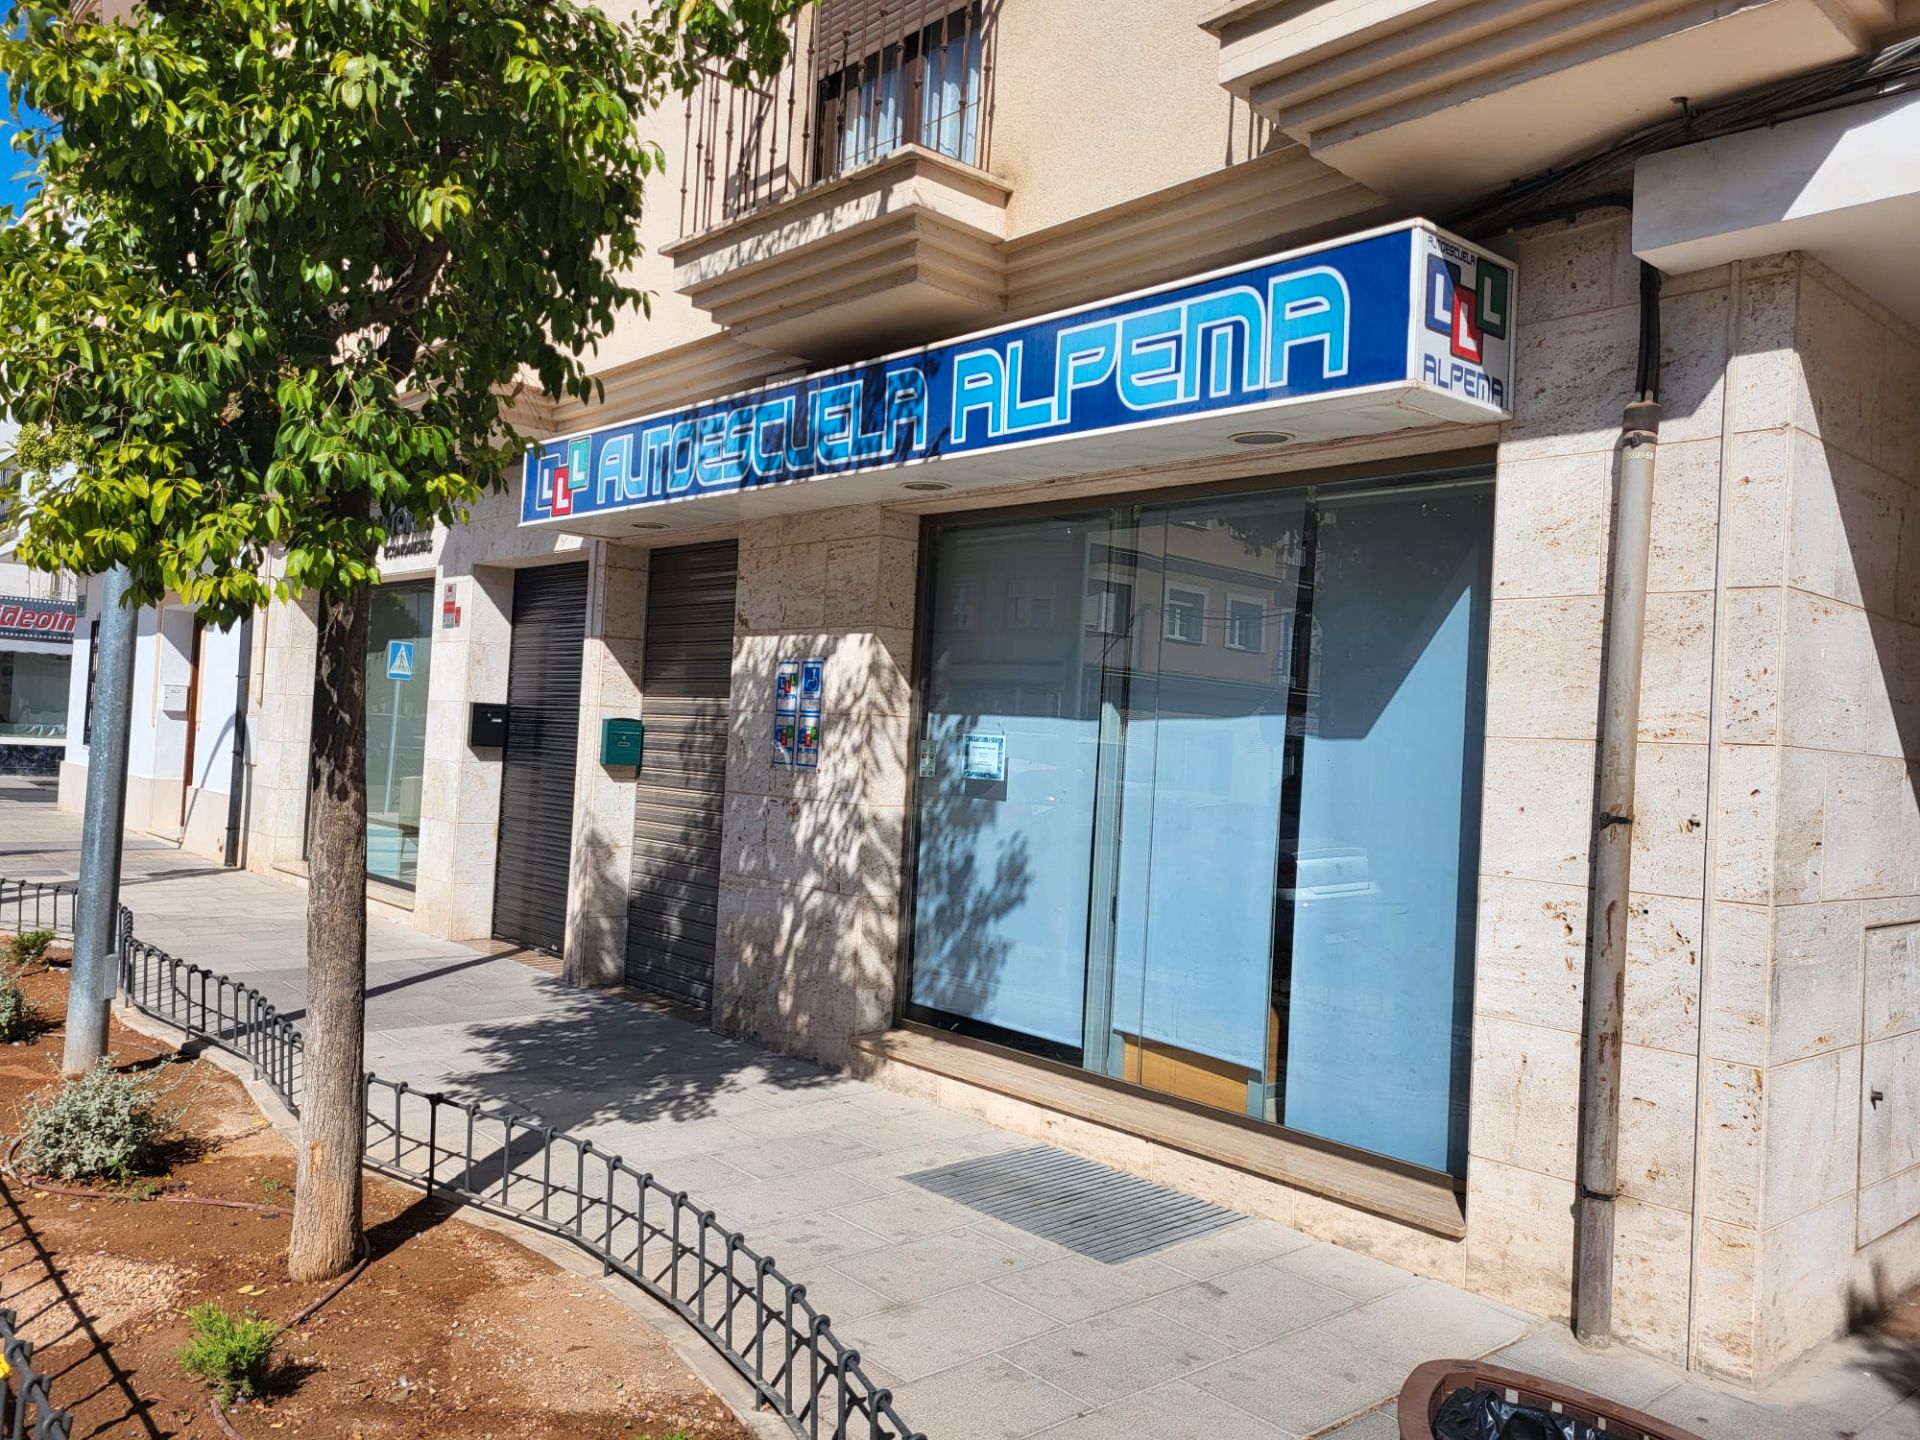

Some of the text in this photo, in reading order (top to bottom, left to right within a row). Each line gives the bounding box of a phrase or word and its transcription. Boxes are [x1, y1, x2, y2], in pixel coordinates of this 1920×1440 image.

[1427, 235, 1476, 267] AUTOESCUELA
[597, 367, 929, 505] AUTOESCUELA
[950, 265, 1351, 445] ALPEMA
[1423, 352, 1504, 409] ALPEMA
[0, 604, 76, 633] deoin
